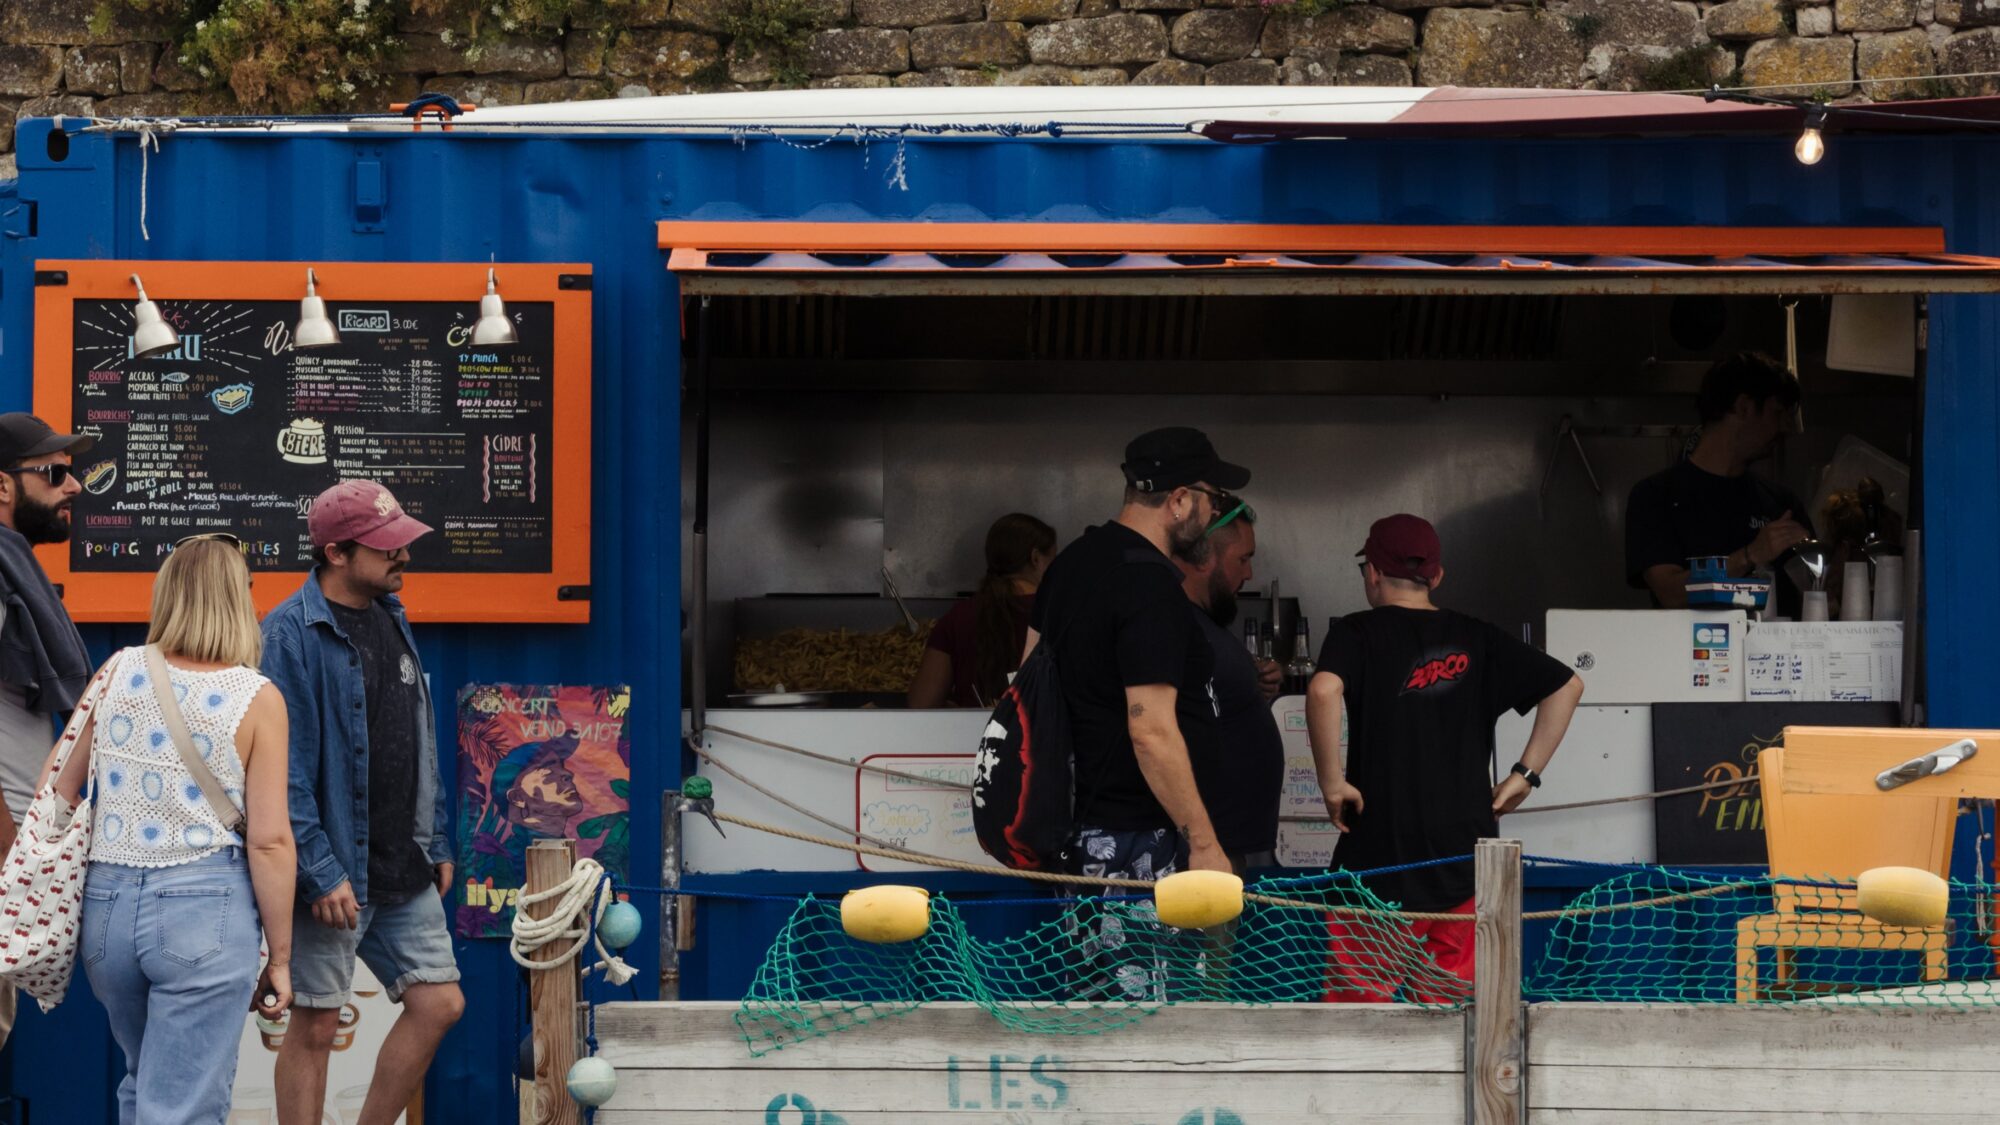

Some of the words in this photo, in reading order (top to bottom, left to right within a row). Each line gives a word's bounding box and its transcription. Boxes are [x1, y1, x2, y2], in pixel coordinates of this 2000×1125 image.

[128, 372, 155, 382] ACCRAS
[128, 382, 160, 392] MOYENNE
[126, 477, 157, 494] DOCKS
[160, 481, 182, 496] ROLL
[141, 516, 156, 526] POT
[160, 516, 168, 526] DE
[171, 515, 190, 526] GLACE
[480, 698, 558, 717] CONCERT
[947, 1054, 1070, 1111] LES
